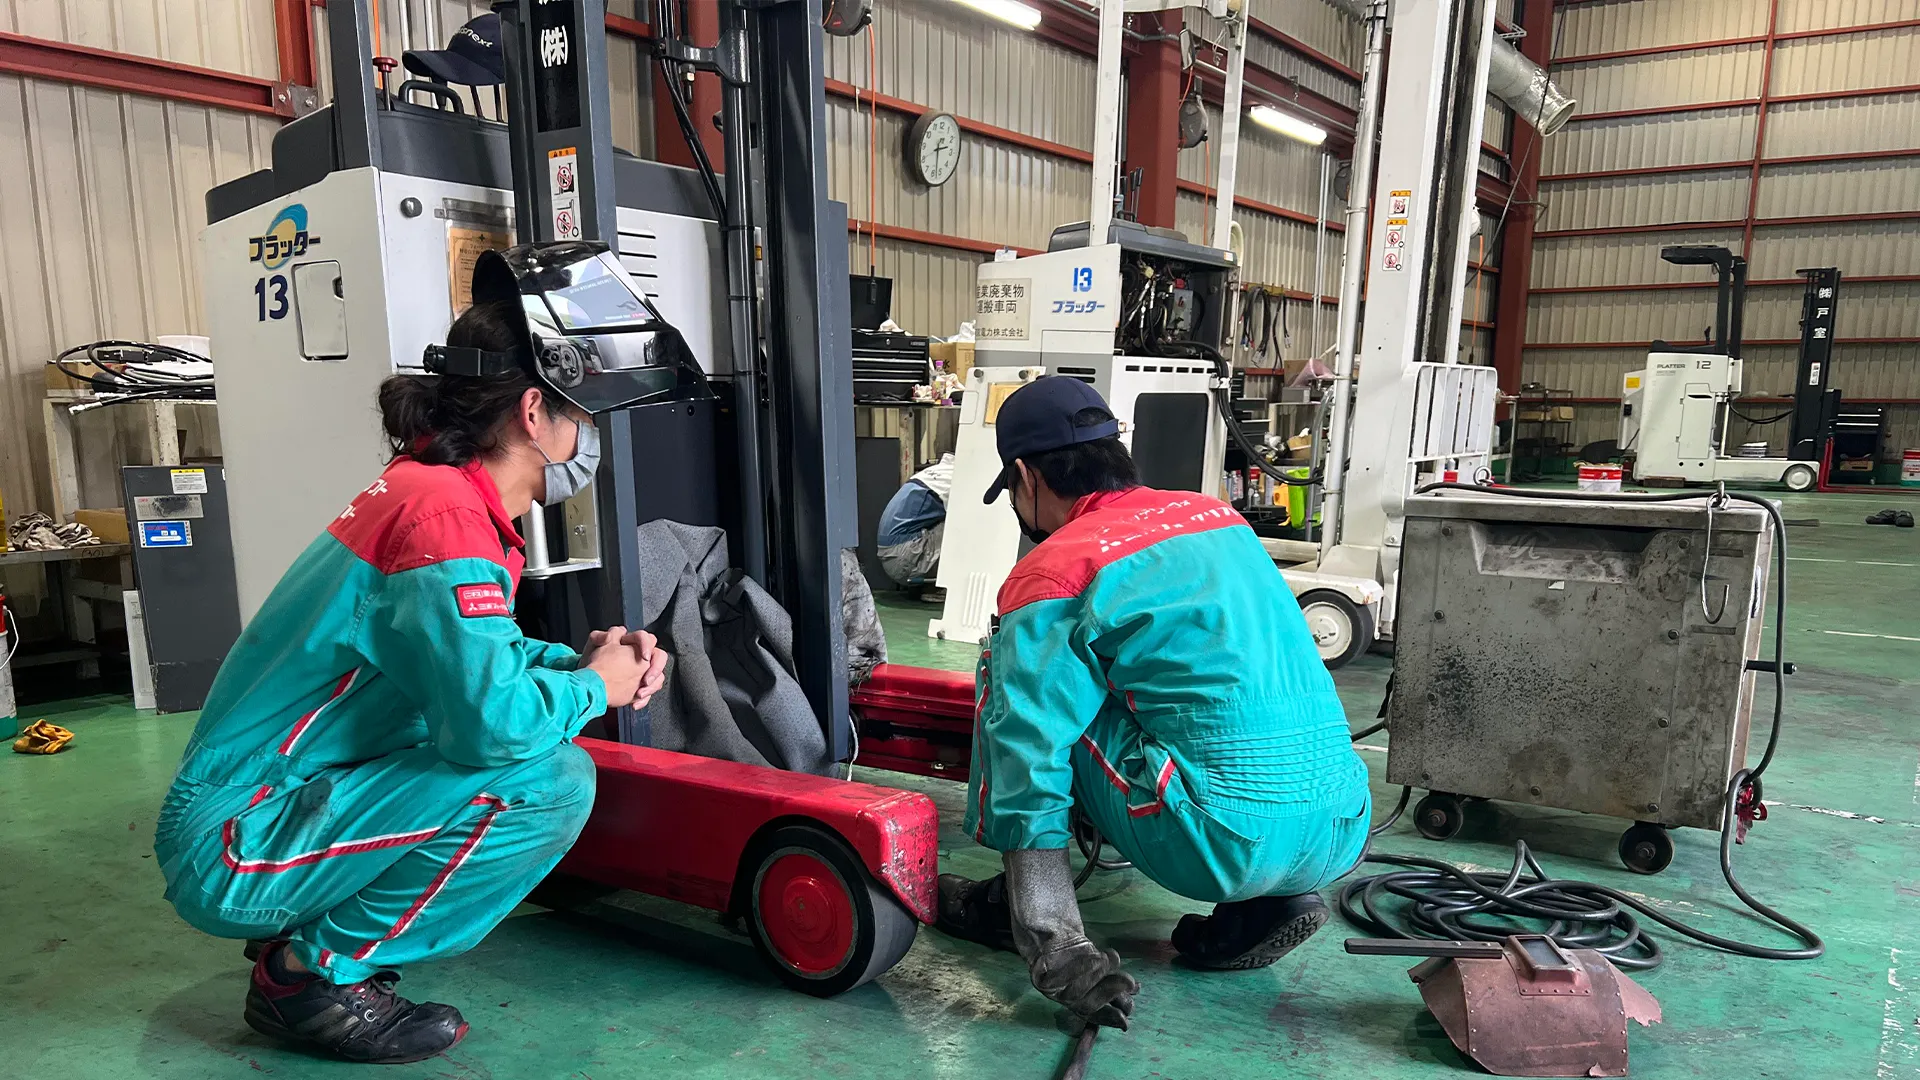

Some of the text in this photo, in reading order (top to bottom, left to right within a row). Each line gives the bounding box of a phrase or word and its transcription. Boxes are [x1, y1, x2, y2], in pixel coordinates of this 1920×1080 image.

[249, 231, 321, 262] プラッター
[1073, 267, 1093, 293] 13
[255, 274, 289, 322] 13
[1696, 360, 1712, 370] 12
